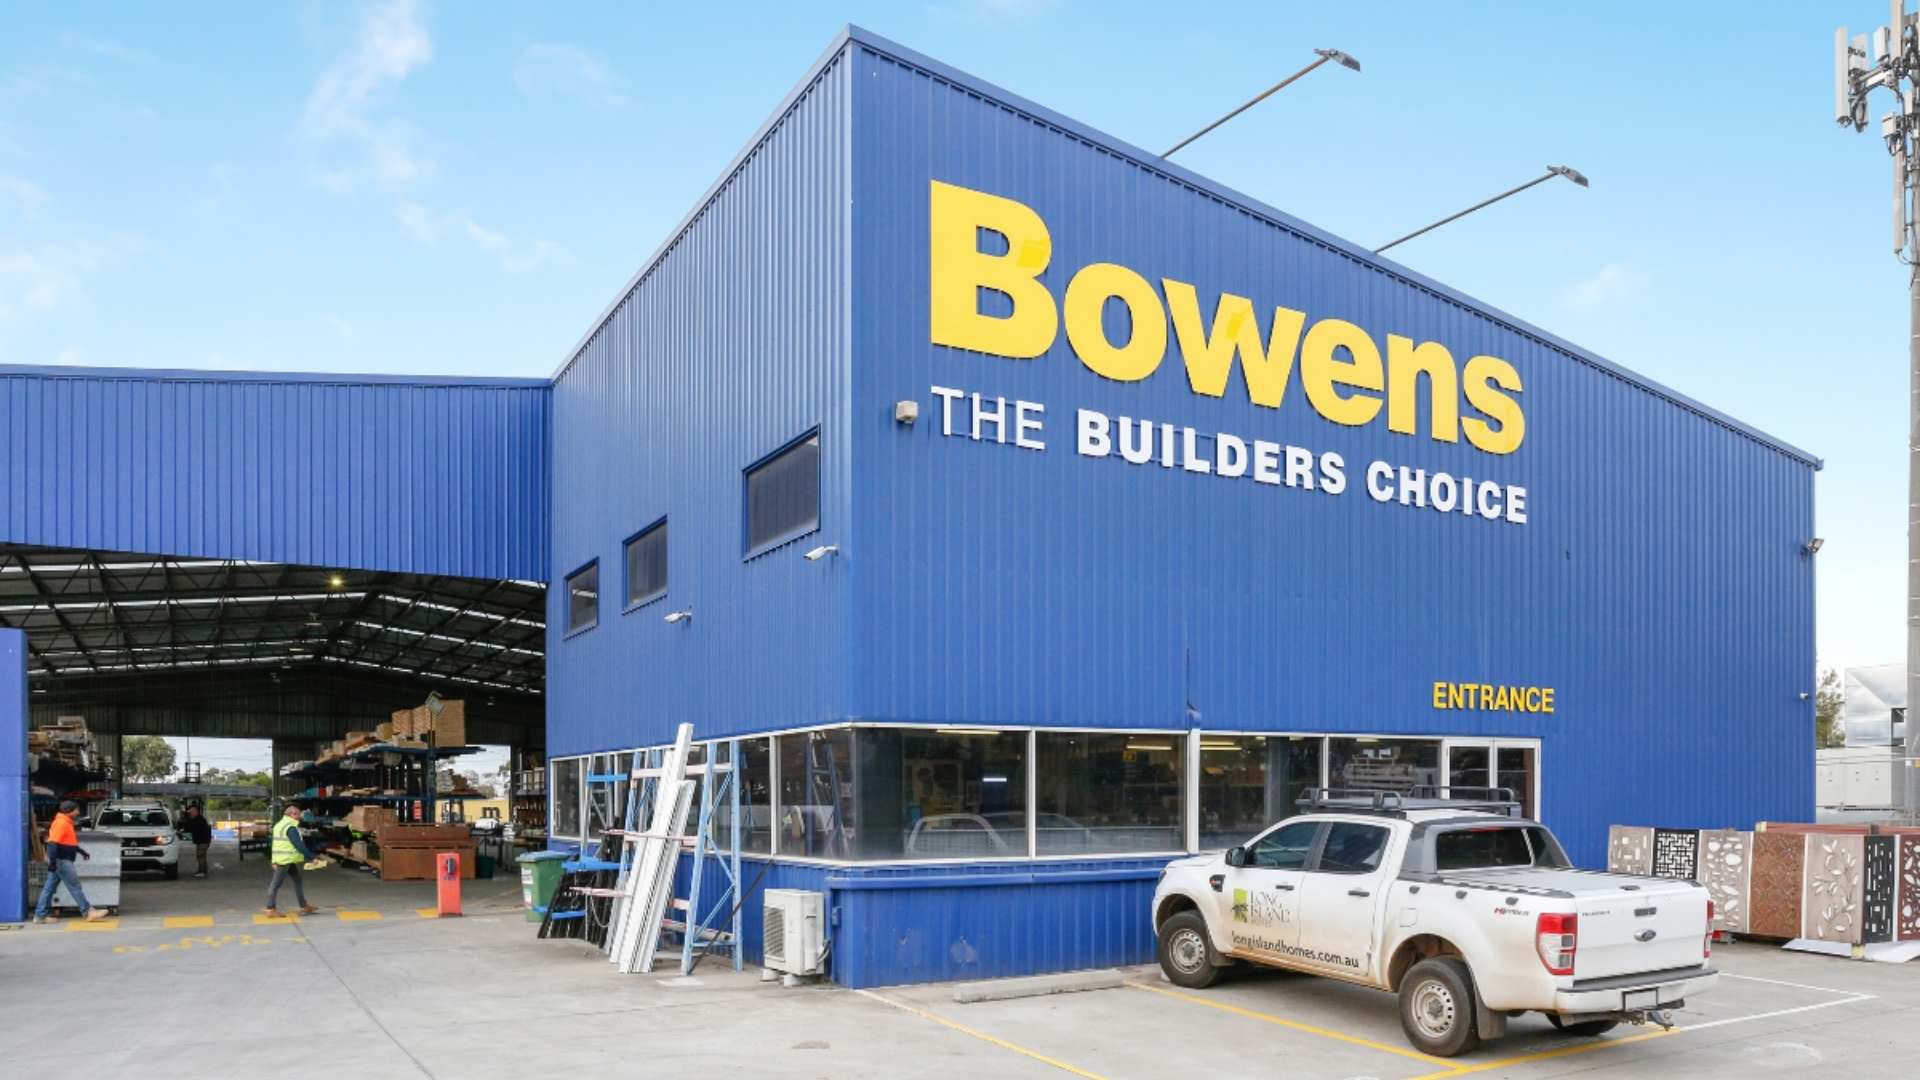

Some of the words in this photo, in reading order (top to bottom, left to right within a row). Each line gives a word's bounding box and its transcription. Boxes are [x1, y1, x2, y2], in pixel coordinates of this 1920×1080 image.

[930, 179, 1527, 455] Bowens
[930, 385, 1045, 450] THE
[1077, 408, 1347, 494] BUILDERS
[1367, 460, 1528, 523] CHOICE
[1432, 681, 1555, 713] ENTRANCE
[1231, 930, 1360, 968] longislandhomes.com.au
